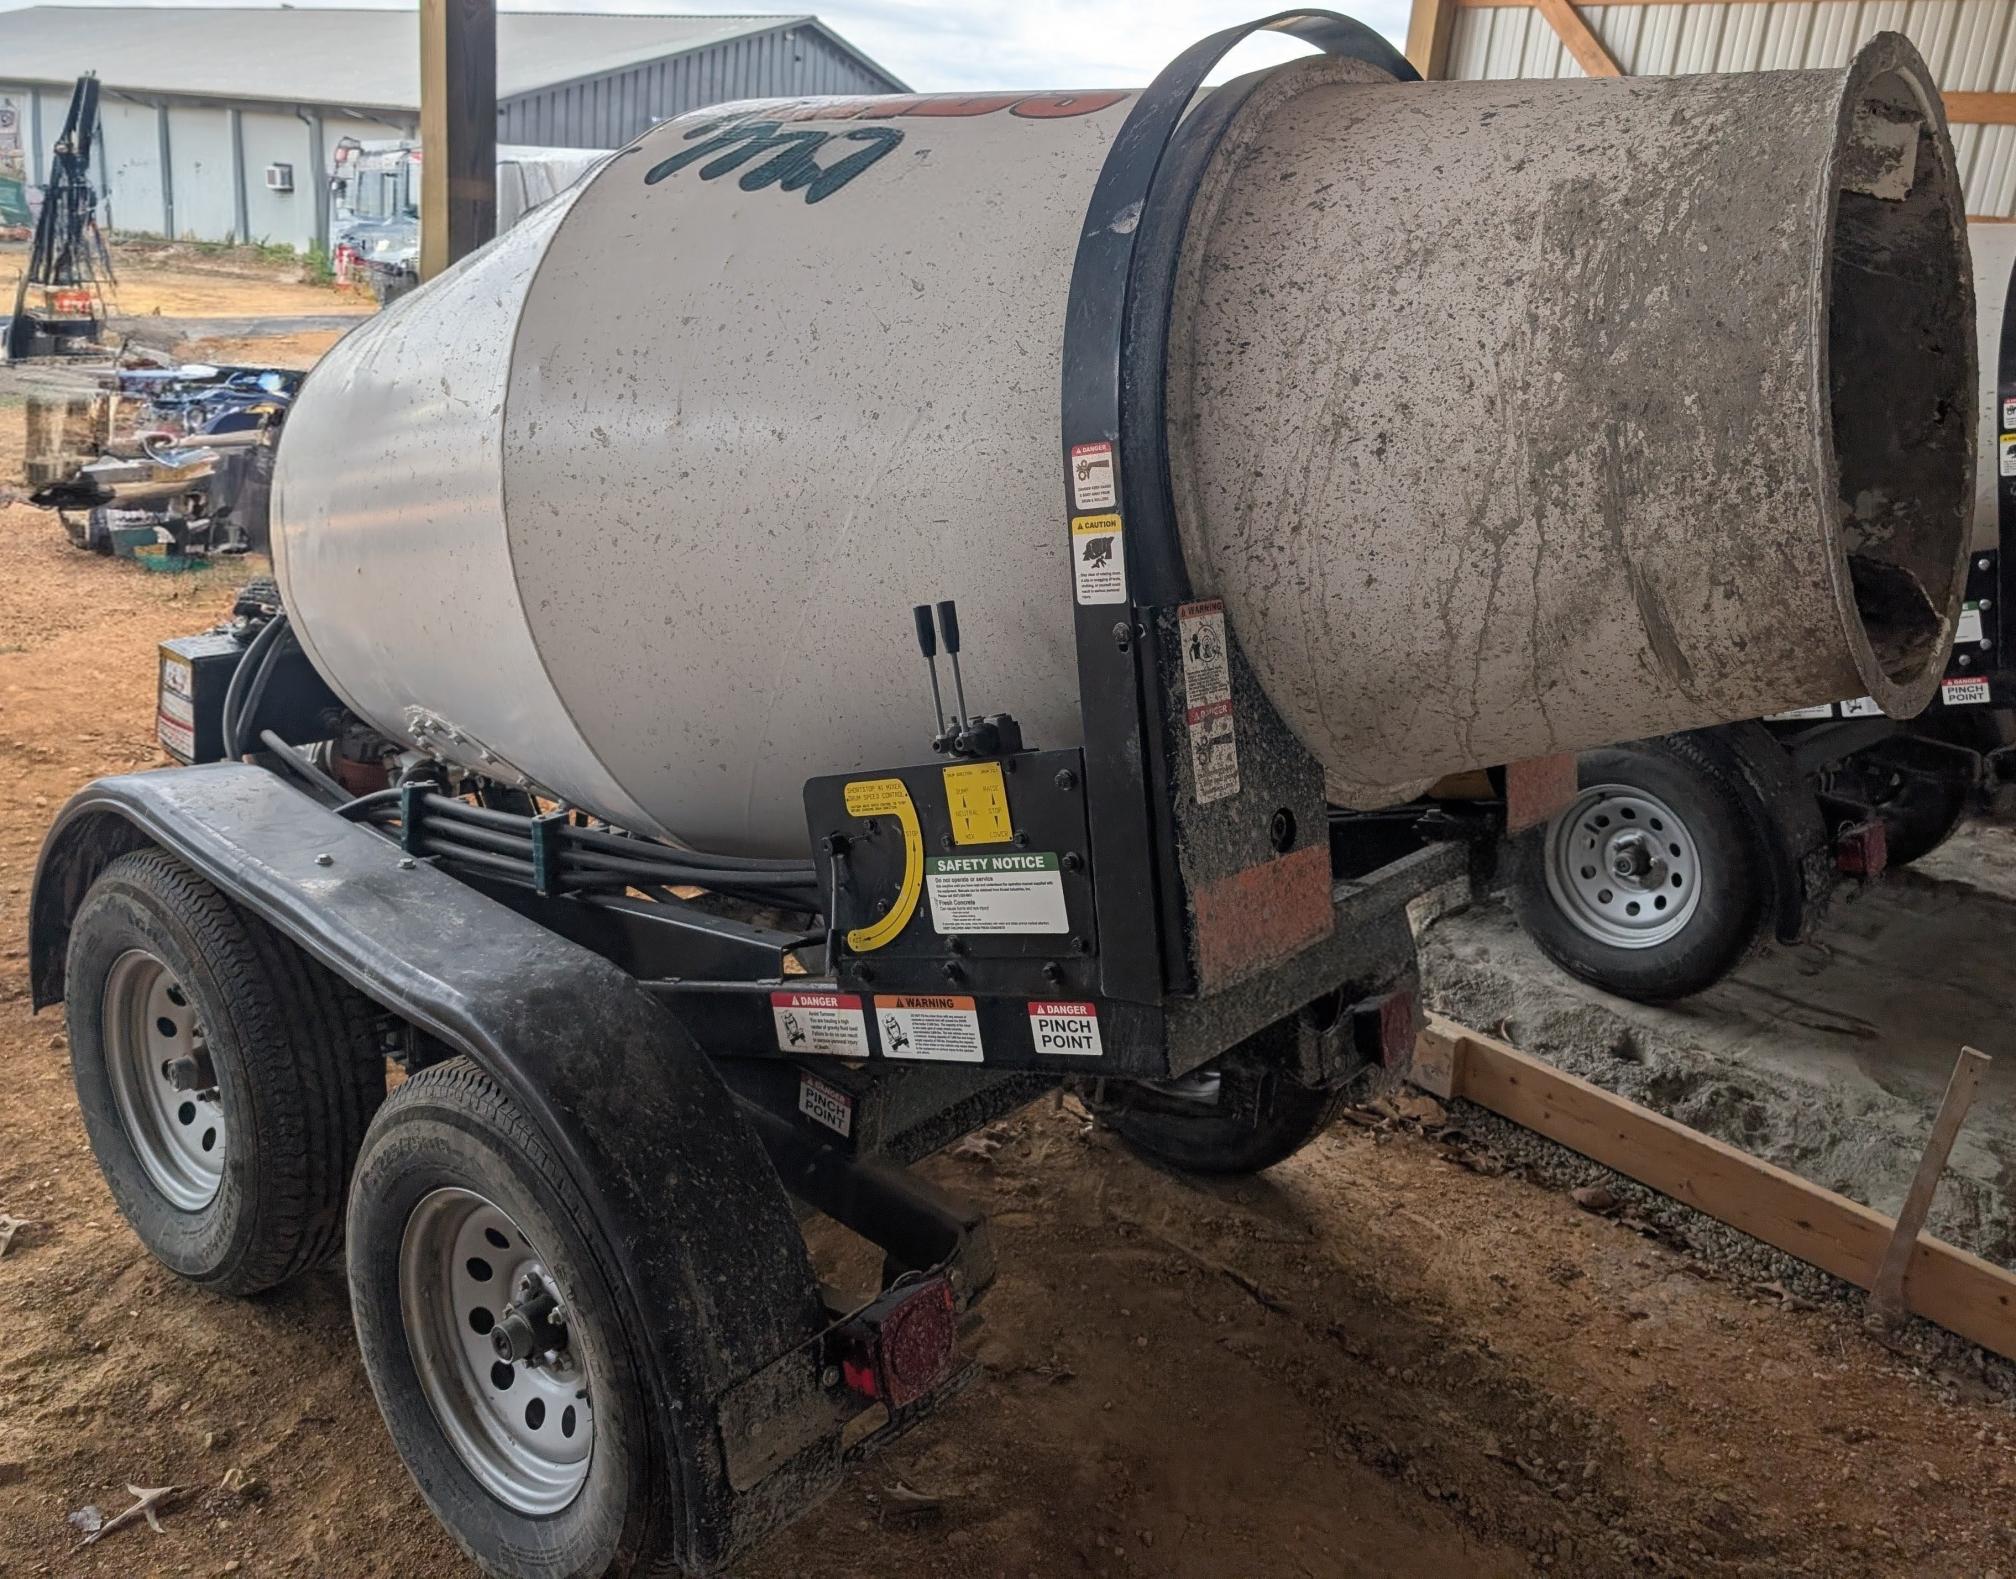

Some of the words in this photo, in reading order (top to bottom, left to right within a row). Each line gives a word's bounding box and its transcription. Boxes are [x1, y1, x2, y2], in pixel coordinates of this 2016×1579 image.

[1082, 444, 1107, 453] DANGER
[1085, 520, 1116, 529] CAUTION
[1188, 602, 1222, 615] WARNING
[1948, 684, 1984, 694] PINCH
[1948, 692, 1984, 702] POINT
[938, 858, 988, 871] SAFETY
[992, 856, 1045, 870] NOTICE
[800, 996, 838, 1007] DANGER
[906, 998, 954, 1008] WARNING
[1047, 1005, 1087, 1014] DANGER
[1039, 1019, 1091, 1033] PINCH
[1042, 1034, 1094, 1049] POINT
[815, 1080, 846, 1102] DANGER
[806, 1088, 845, 1118] PINCH
[806, 1100, 844, 1128] POINT
